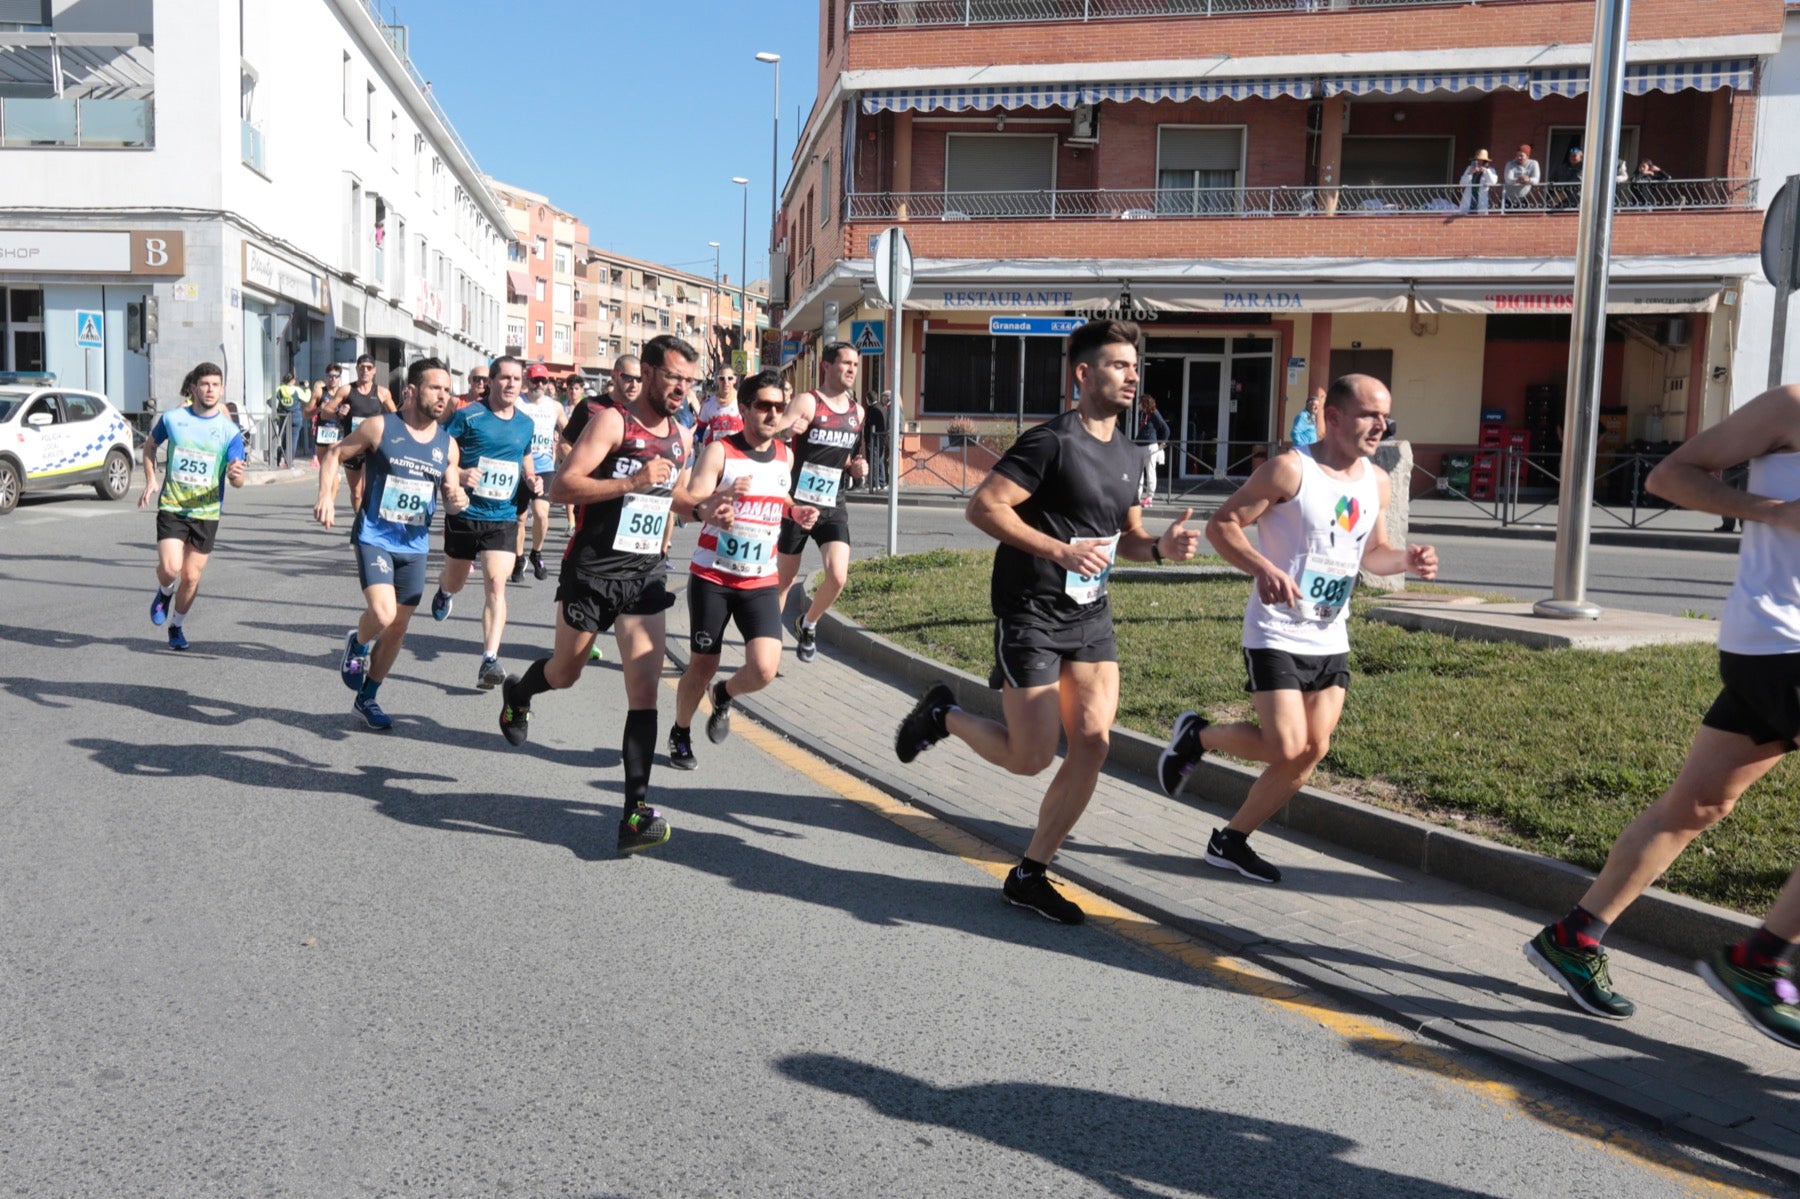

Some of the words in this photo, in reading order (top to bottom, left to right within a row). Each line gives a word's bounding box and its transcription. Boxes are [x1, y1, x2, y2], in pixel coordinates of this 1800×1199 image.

[145, 238, 169, 267] B
[943, 291, 1073, 307] RESTAURANTE
[1223, 292, 1303, 308] PARADA
[1075, 309, 1159, 321] BICHITOS
[992, 321, 1031, 331] Granada
[1052, 322, 1071, 331] A-44
[179, 458, 208, 475] 253
[389, 457, 415, 469] PAZITO
[420, 464, 442, 477] PAZITO
[482, 470, 514, 487] 1191
[807, 476, 835, 494] 127
[397, 493, 421, 511] 88
[629, 512, 663, 536] 580
[726, 538, 762, 561] 911
